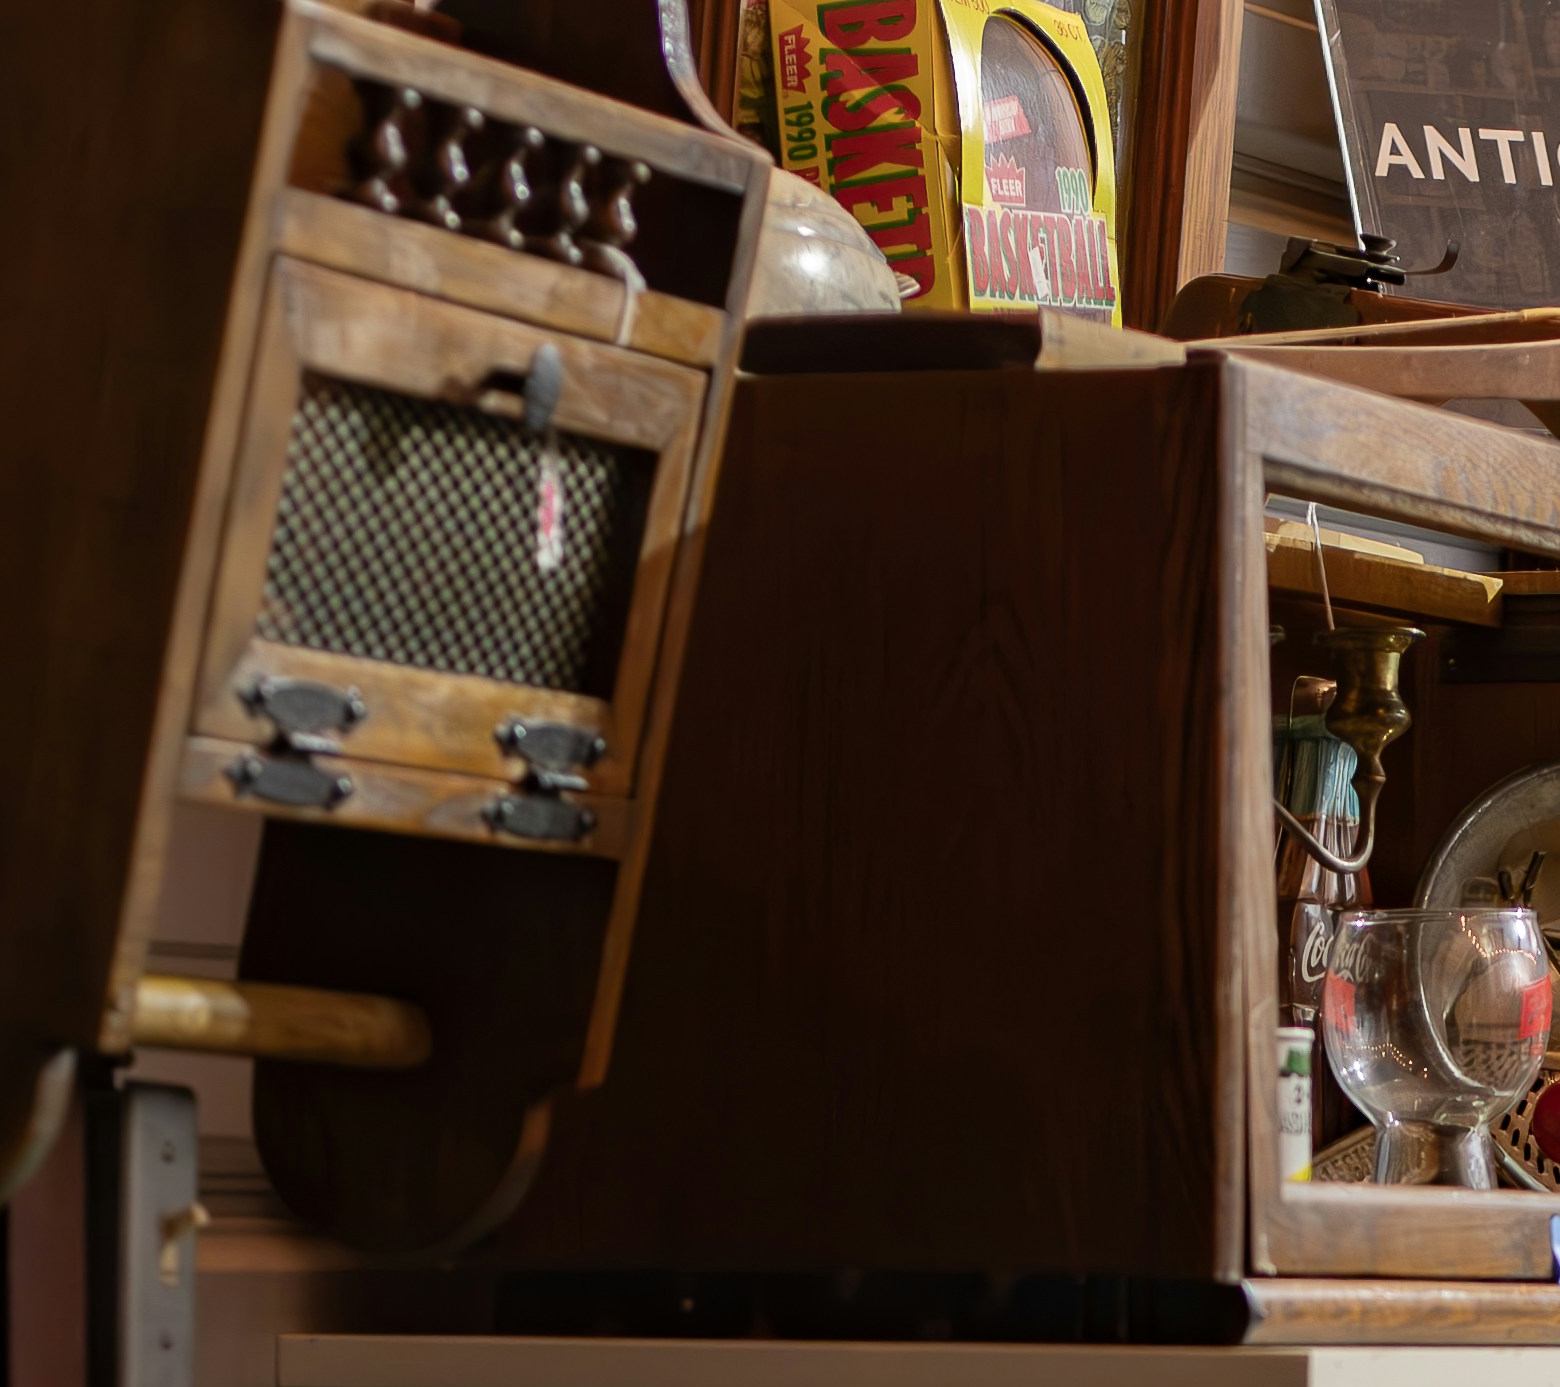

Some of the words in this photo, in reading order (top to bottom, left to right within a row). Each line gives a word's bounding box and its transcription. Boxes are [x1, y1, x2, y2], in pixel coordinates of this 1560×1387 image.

[783, 34, 798, 91] FLEER
[784, 101, 818, 162] 1990
[990, 177, 1023, 198] FLEER
[1056, 167, 1090, 213] 1990
[968, 207, 1116, 309] BASKETBALL
